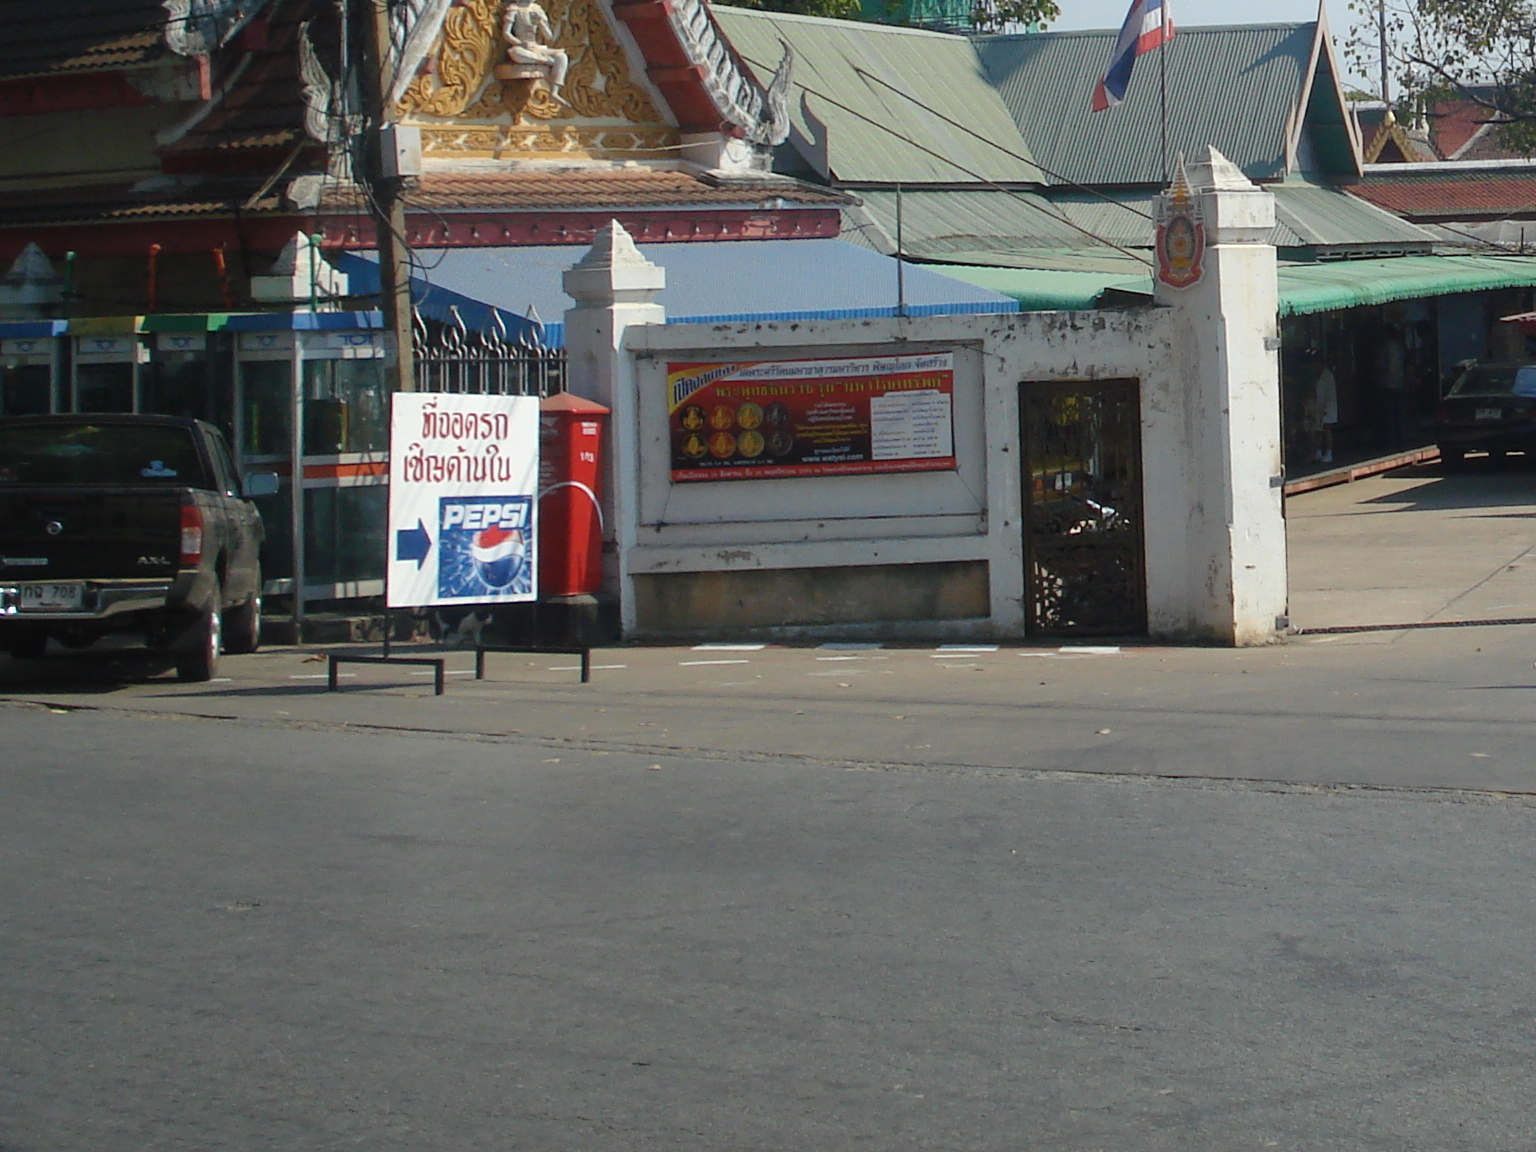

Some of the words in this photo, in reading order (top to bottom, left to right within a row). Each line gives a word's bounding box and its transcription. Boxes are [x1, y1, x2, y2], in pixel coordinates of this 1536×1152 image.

[421, 396, 509, 440] ที่จอดรถ
[403, 443, 512, 483] เชิญด้านใน
[443, 503, 528, 530] PEPSI
